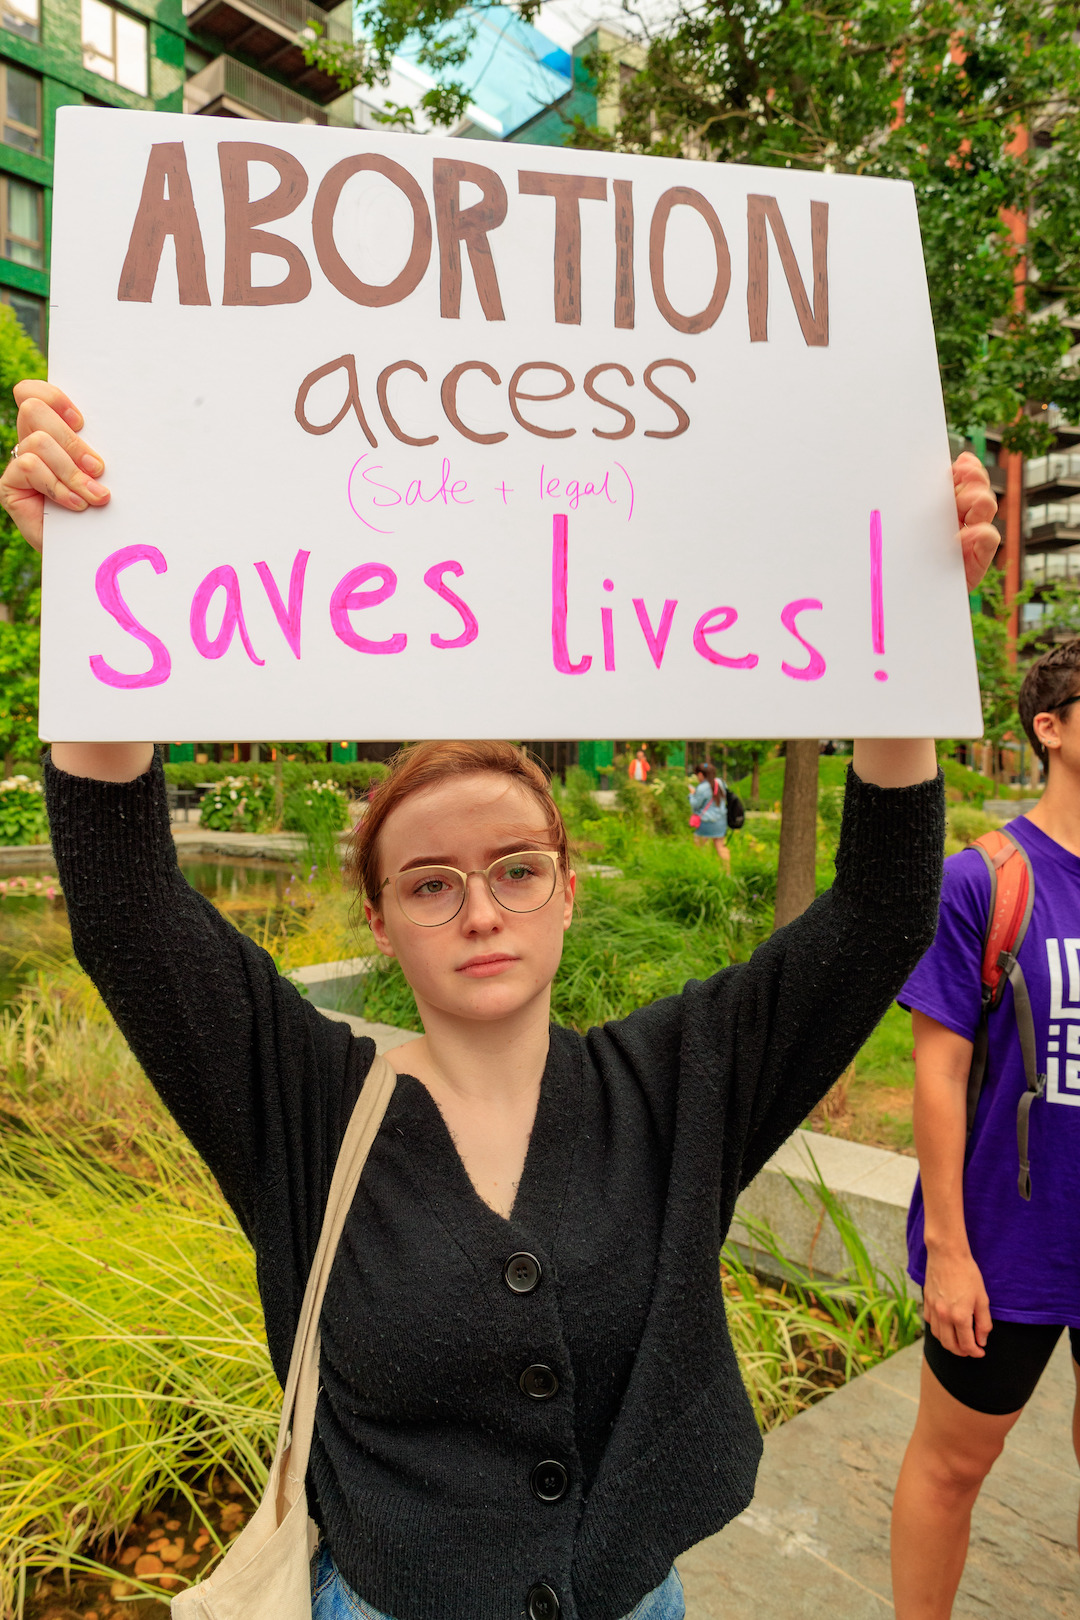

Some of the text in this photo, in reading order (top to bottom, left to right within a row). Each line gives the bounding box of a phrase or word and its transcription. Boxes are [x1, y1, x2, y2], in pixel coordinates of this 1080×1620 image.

[118, 142, 829, 347] ABORTION
[295, 354, 696, 448] access
[494, 481, 514, 505] +
[539, 461, 634, 522] legal)
[88, 544, 479, 690] Saves
